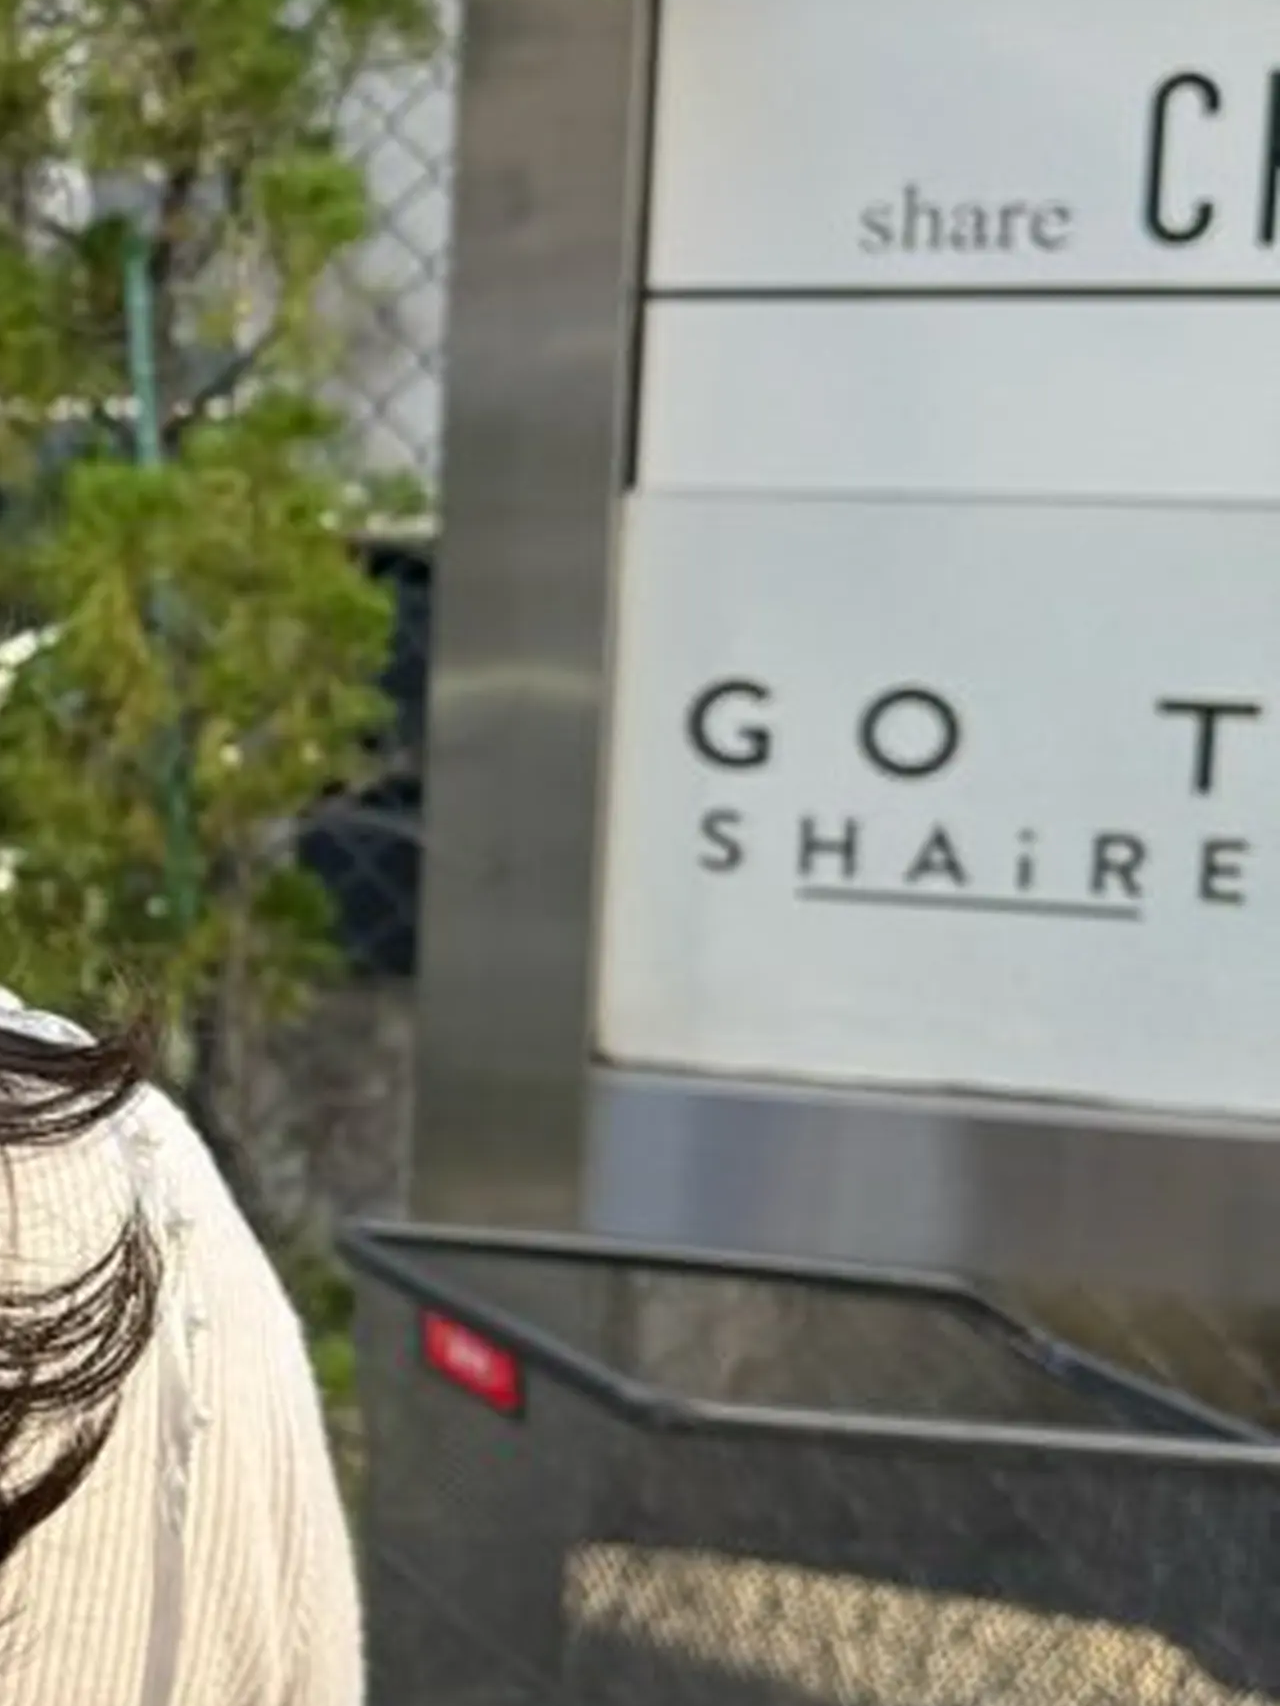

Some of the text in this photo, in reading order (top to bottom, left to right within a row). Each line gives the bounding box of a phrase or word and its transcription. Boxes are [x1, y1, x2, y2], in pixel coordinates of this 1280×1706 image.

[857, 70, 1280, 253] share C
[686, 678, 961, 781] GO
